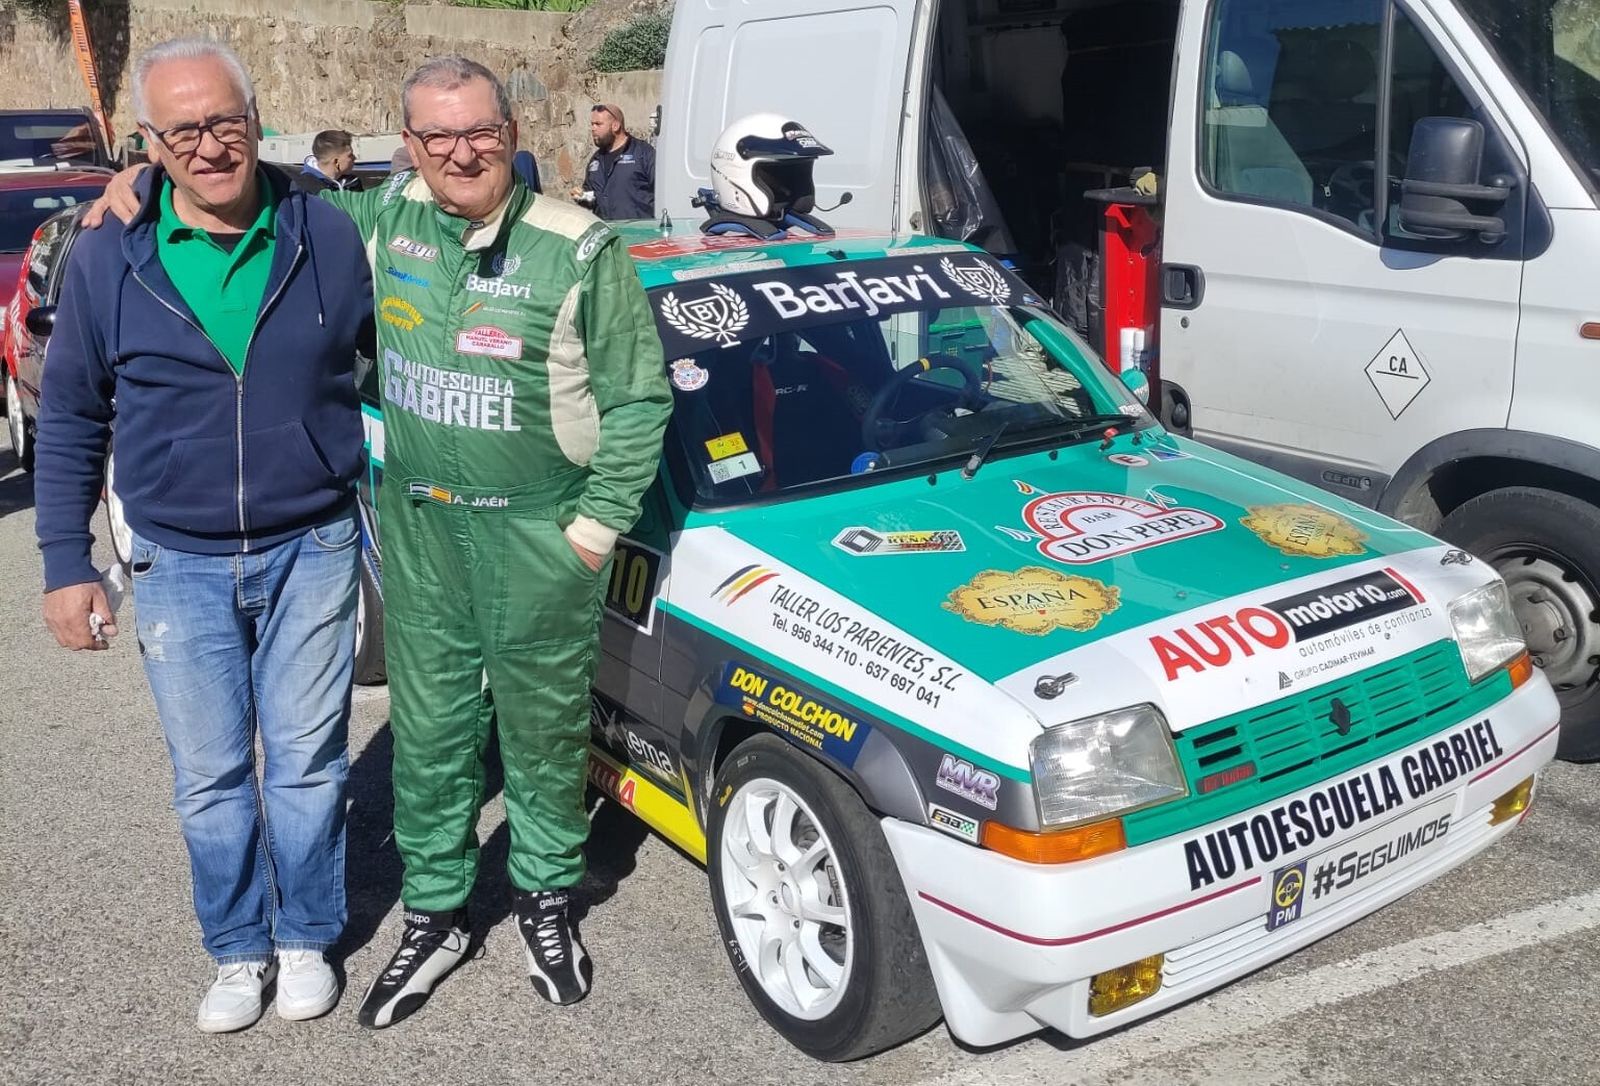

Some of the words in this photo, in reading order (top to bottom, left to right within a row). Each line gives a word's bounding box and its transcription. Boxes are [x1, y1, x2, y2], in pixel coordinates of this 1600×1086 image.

[466, 273, 531, 299] BarJavi
[752, 265, 951, 319] BarJavi
[690, 301, 722, 322] BJ
[404, 360, 515, 397] AUTOESCUELA
[1390, 355, 1408, 374] CA
[384, 347, 522, 432] GABRIEL
[453, 495, 468, 505] A.
[472, 495, 509, 507] JAÉN
[1037, 495, 1147, 531] RESTAURANTE
[1081, 510, 1116, 524] BAR
[1057, 530, 1134, 557] DON
[1126, 512, 1206, 540] PEPE
[612, 548, 648, 613] 10
[770, 584, 821, 623] TALLER
[815, 607, 850, 634] LOS
[843, 621, 934, 680] PARIENTES,
[930, 666, 964, 692] S.L.
[1148, 606, 1290, 682] AUTO
[1299, 627, 1369, 658] automóviles
[1367, 622, 1382, 636] de
[1383, 607, 1433, 630] confianza
[771, 612, 789, 634] Tel.
[791, 623, 812, 644] 956
[812, 633, 834, 656] 344
[835, 645, 858, 667] 710
[864, 660, 889, 682] 637
[890, 673, 914, 696] 697
[916, 686, 942, 710] 041
[1293, 664, 1319, 680] GRUPO
[1318, 646, 1376, 673] CADIMAR-FEVIMAR
[730, 667, 768, 698] DON
[769, 686, 858, 742] COLCHON
[756, 710, 789, 732] PRODUCTO
[788, 726, 823, 750] NACIONAL
[939, 756, 998, 800] MVR
[1183, 764, 1404, 892] AUTOESCUELA
[1400, 718, 1503, 799] GABRIEL
[1274, 905, 1298, 928] PM
